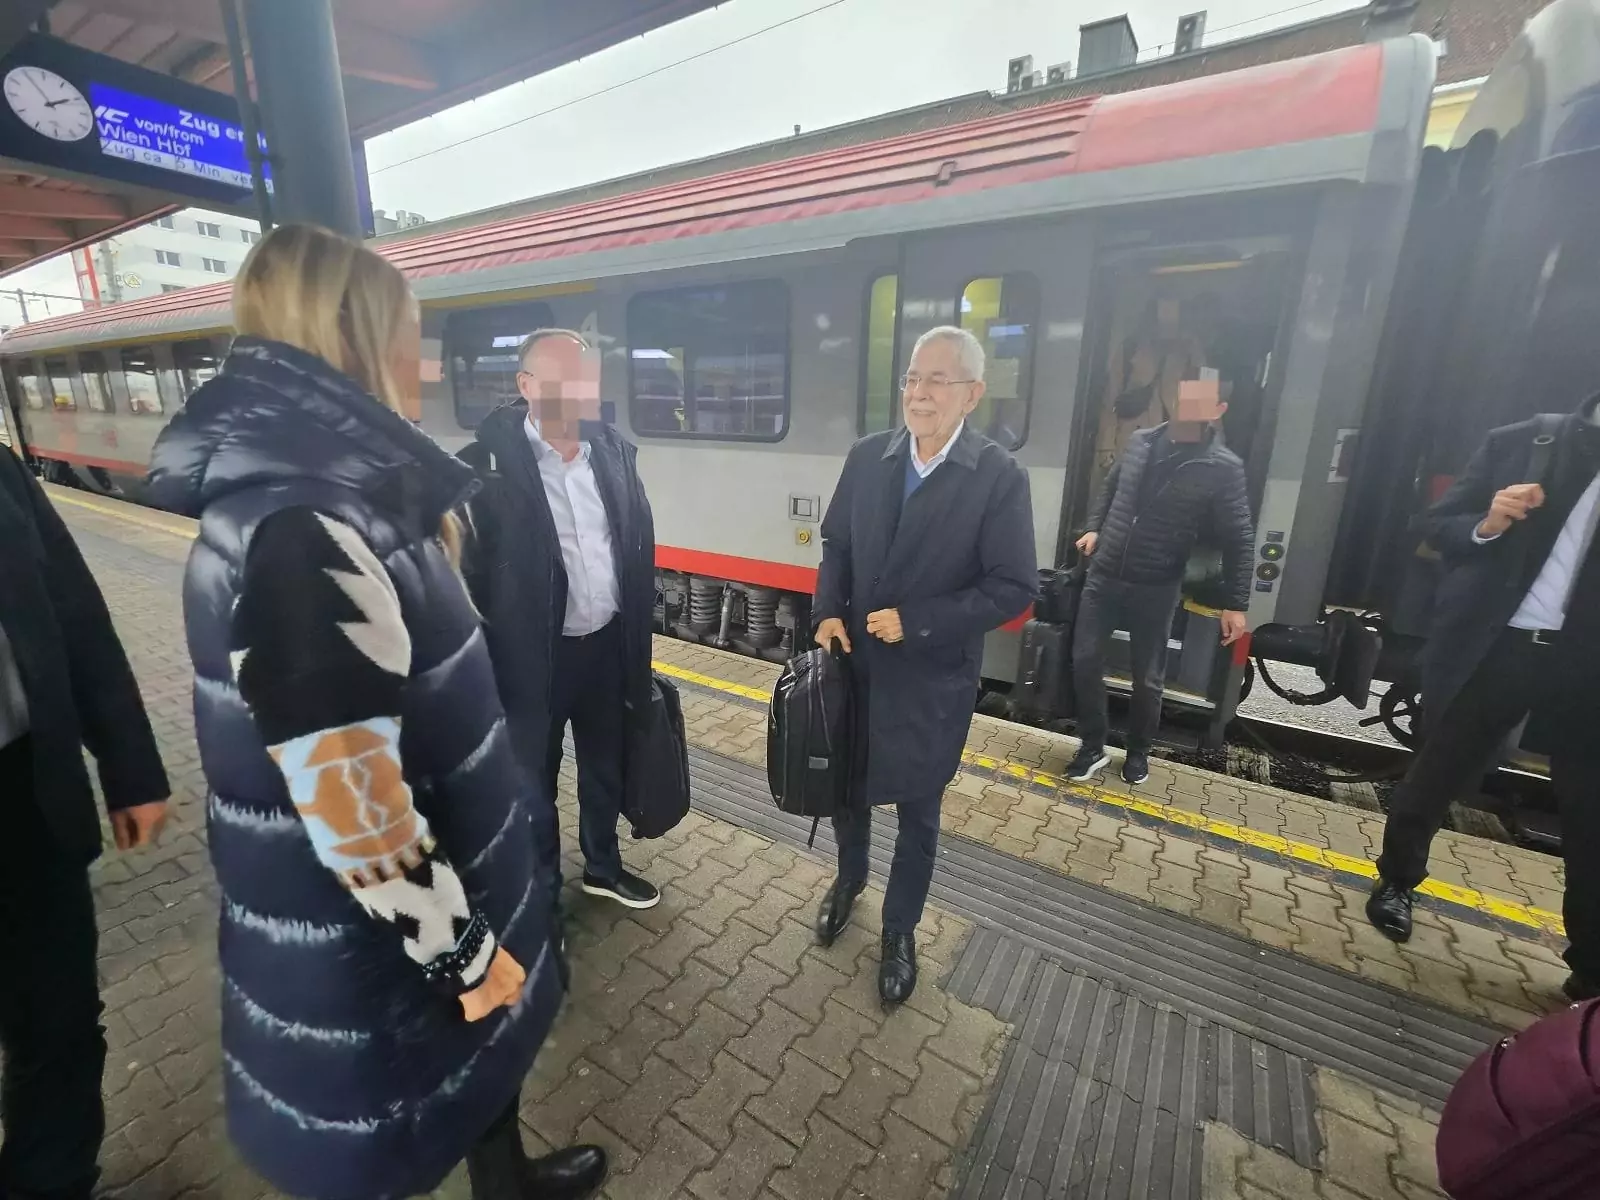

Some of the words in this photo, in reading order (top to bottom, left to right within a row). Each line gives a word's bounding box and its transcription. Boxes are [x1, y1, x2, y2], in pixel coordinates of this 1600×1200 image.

[96, 120, 151, 148] Wien
[156, 136, 192, 157] Hbf
[134, 117, 204, 146] von/from
[179, 110, 220, 138] Zug
